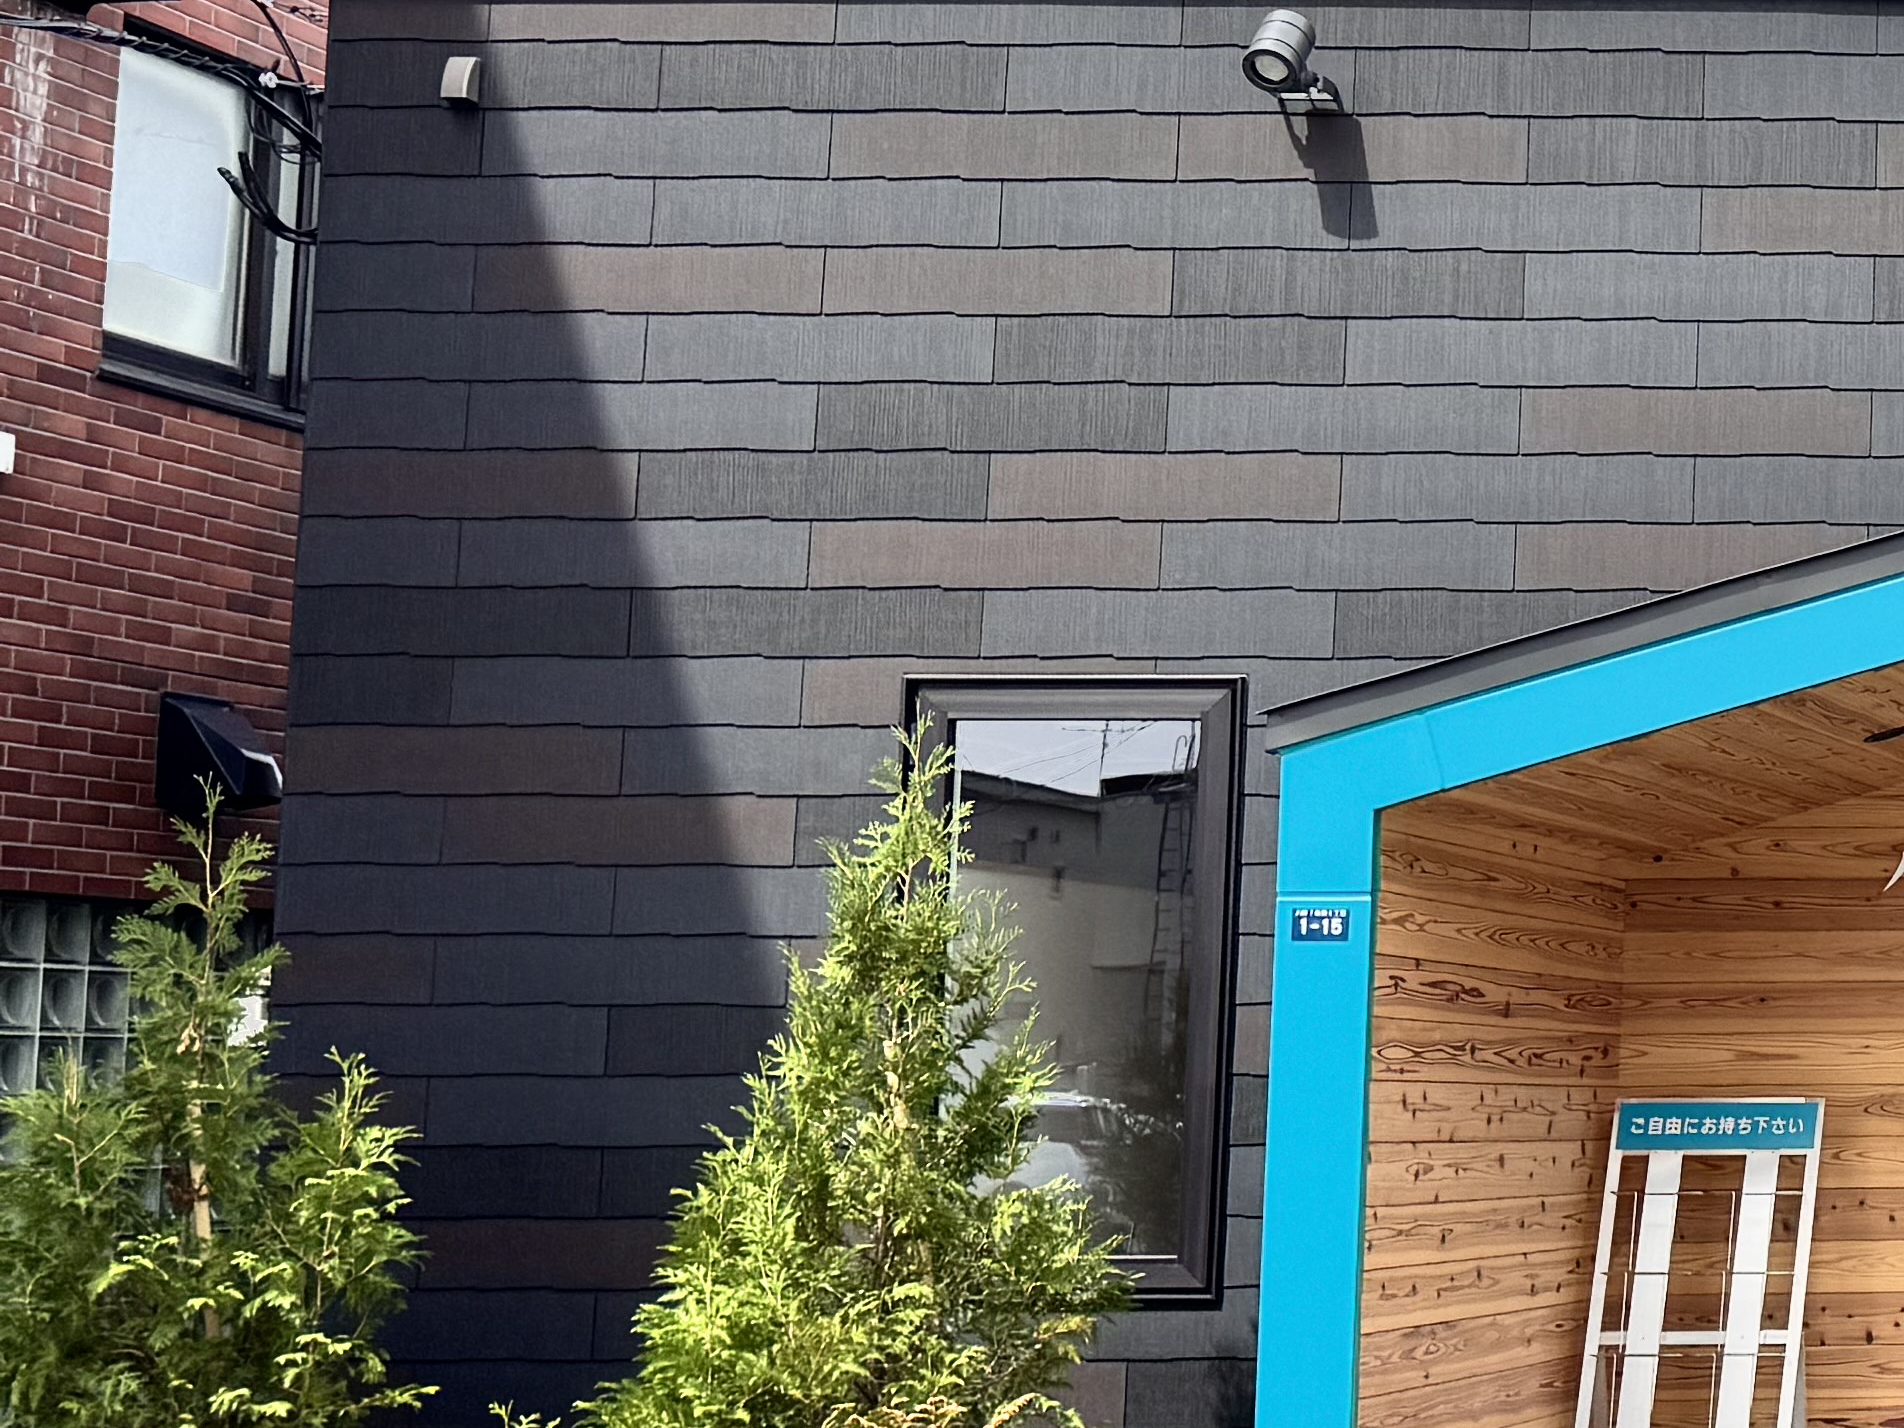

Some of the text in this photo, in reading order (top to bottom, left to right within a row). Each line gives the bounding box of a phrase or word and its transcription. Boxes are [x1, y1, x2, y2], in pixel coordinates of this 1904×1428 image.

[1630, 1116, 1805, 1135] ご自由にお持ち下さい
